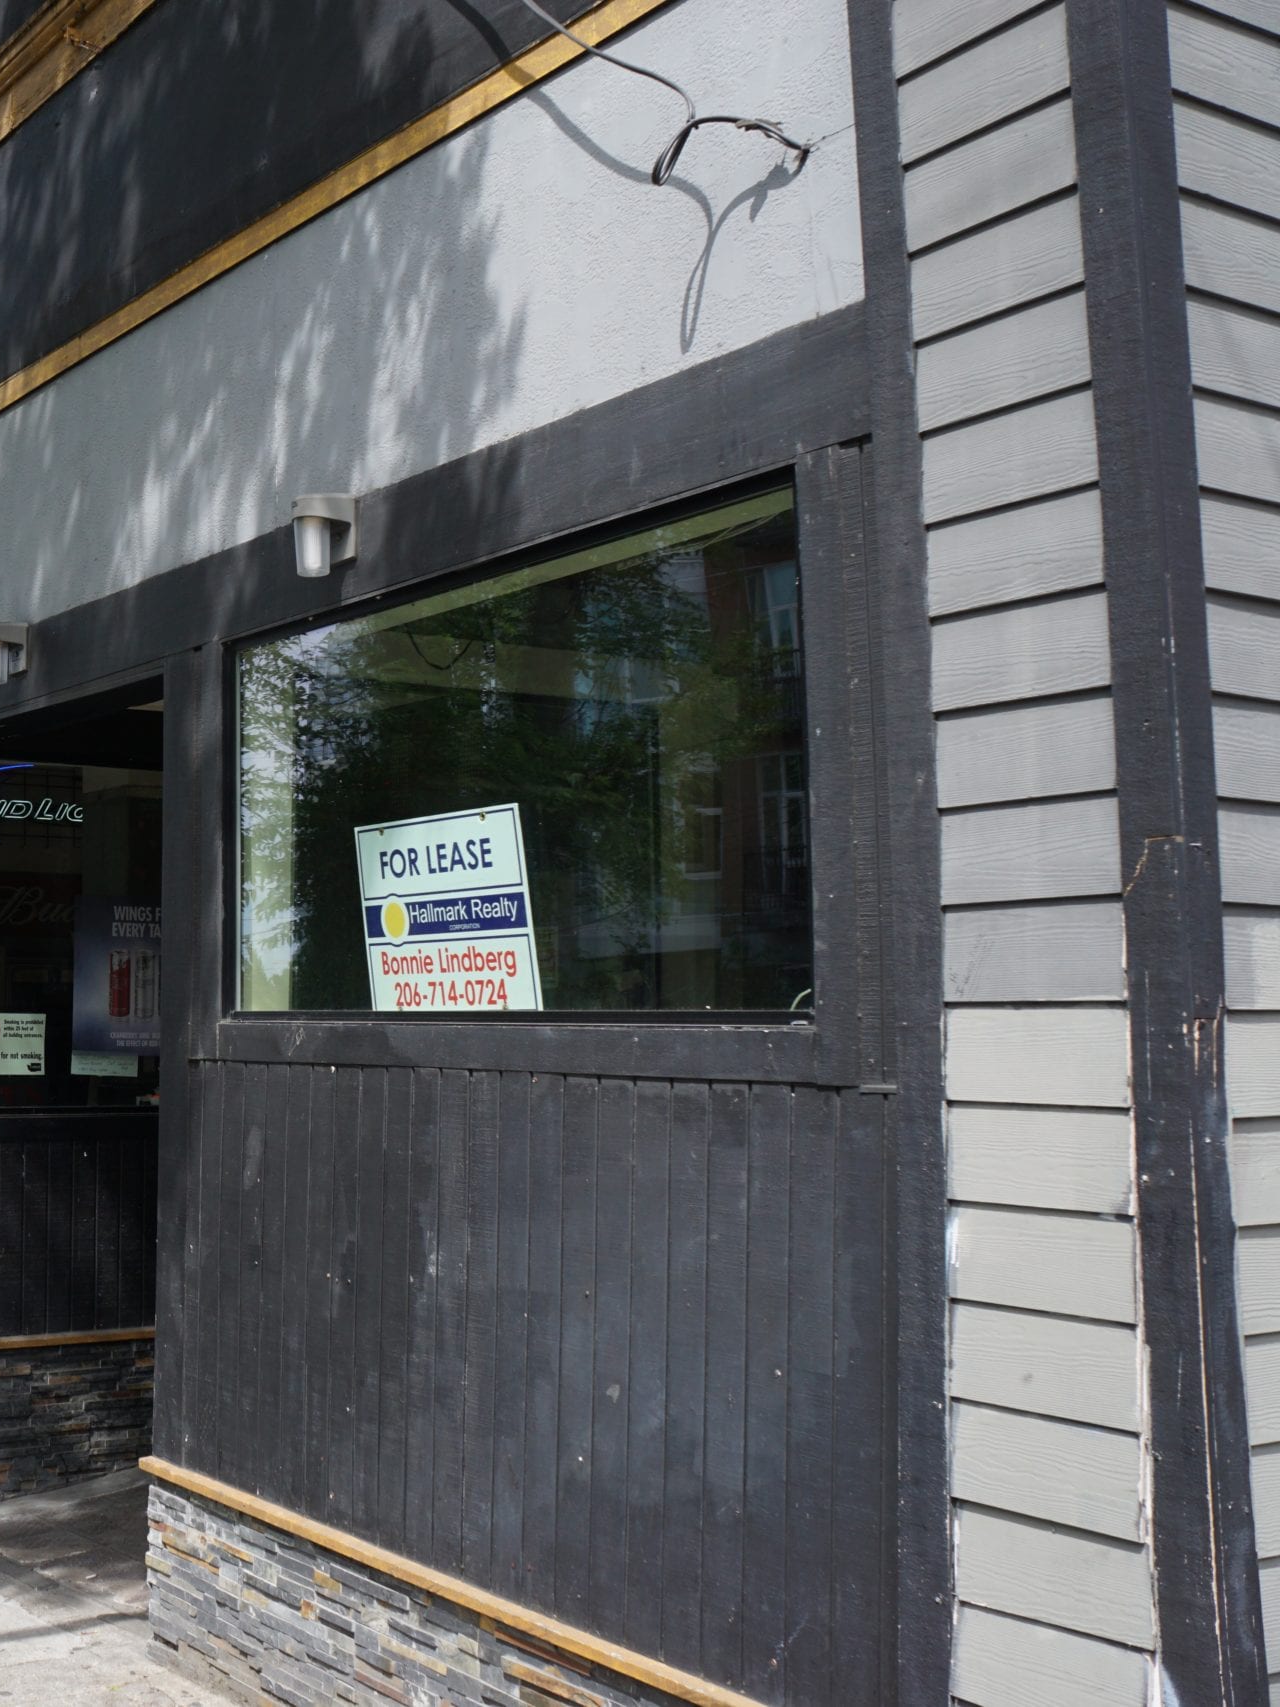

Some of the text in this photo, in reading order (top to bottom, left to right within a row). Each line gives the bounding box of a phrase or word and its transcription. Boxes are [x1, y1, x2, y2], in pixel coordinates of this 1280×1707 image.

[34, 798, 84, 823] LIG
[379, 837, 493, 880] FOR LEASE
[112, 905, 153, 922] WINGS
[409, 897, 518, 925] Hallmark Realty
[111, 922, 161, 938] EVERY TA
[448, 922, 481, 931] CORPORATION
[381, 946, 517, 977] Bonnie Lindberg
[394, 978, 508, 1008] 206-714-0724
